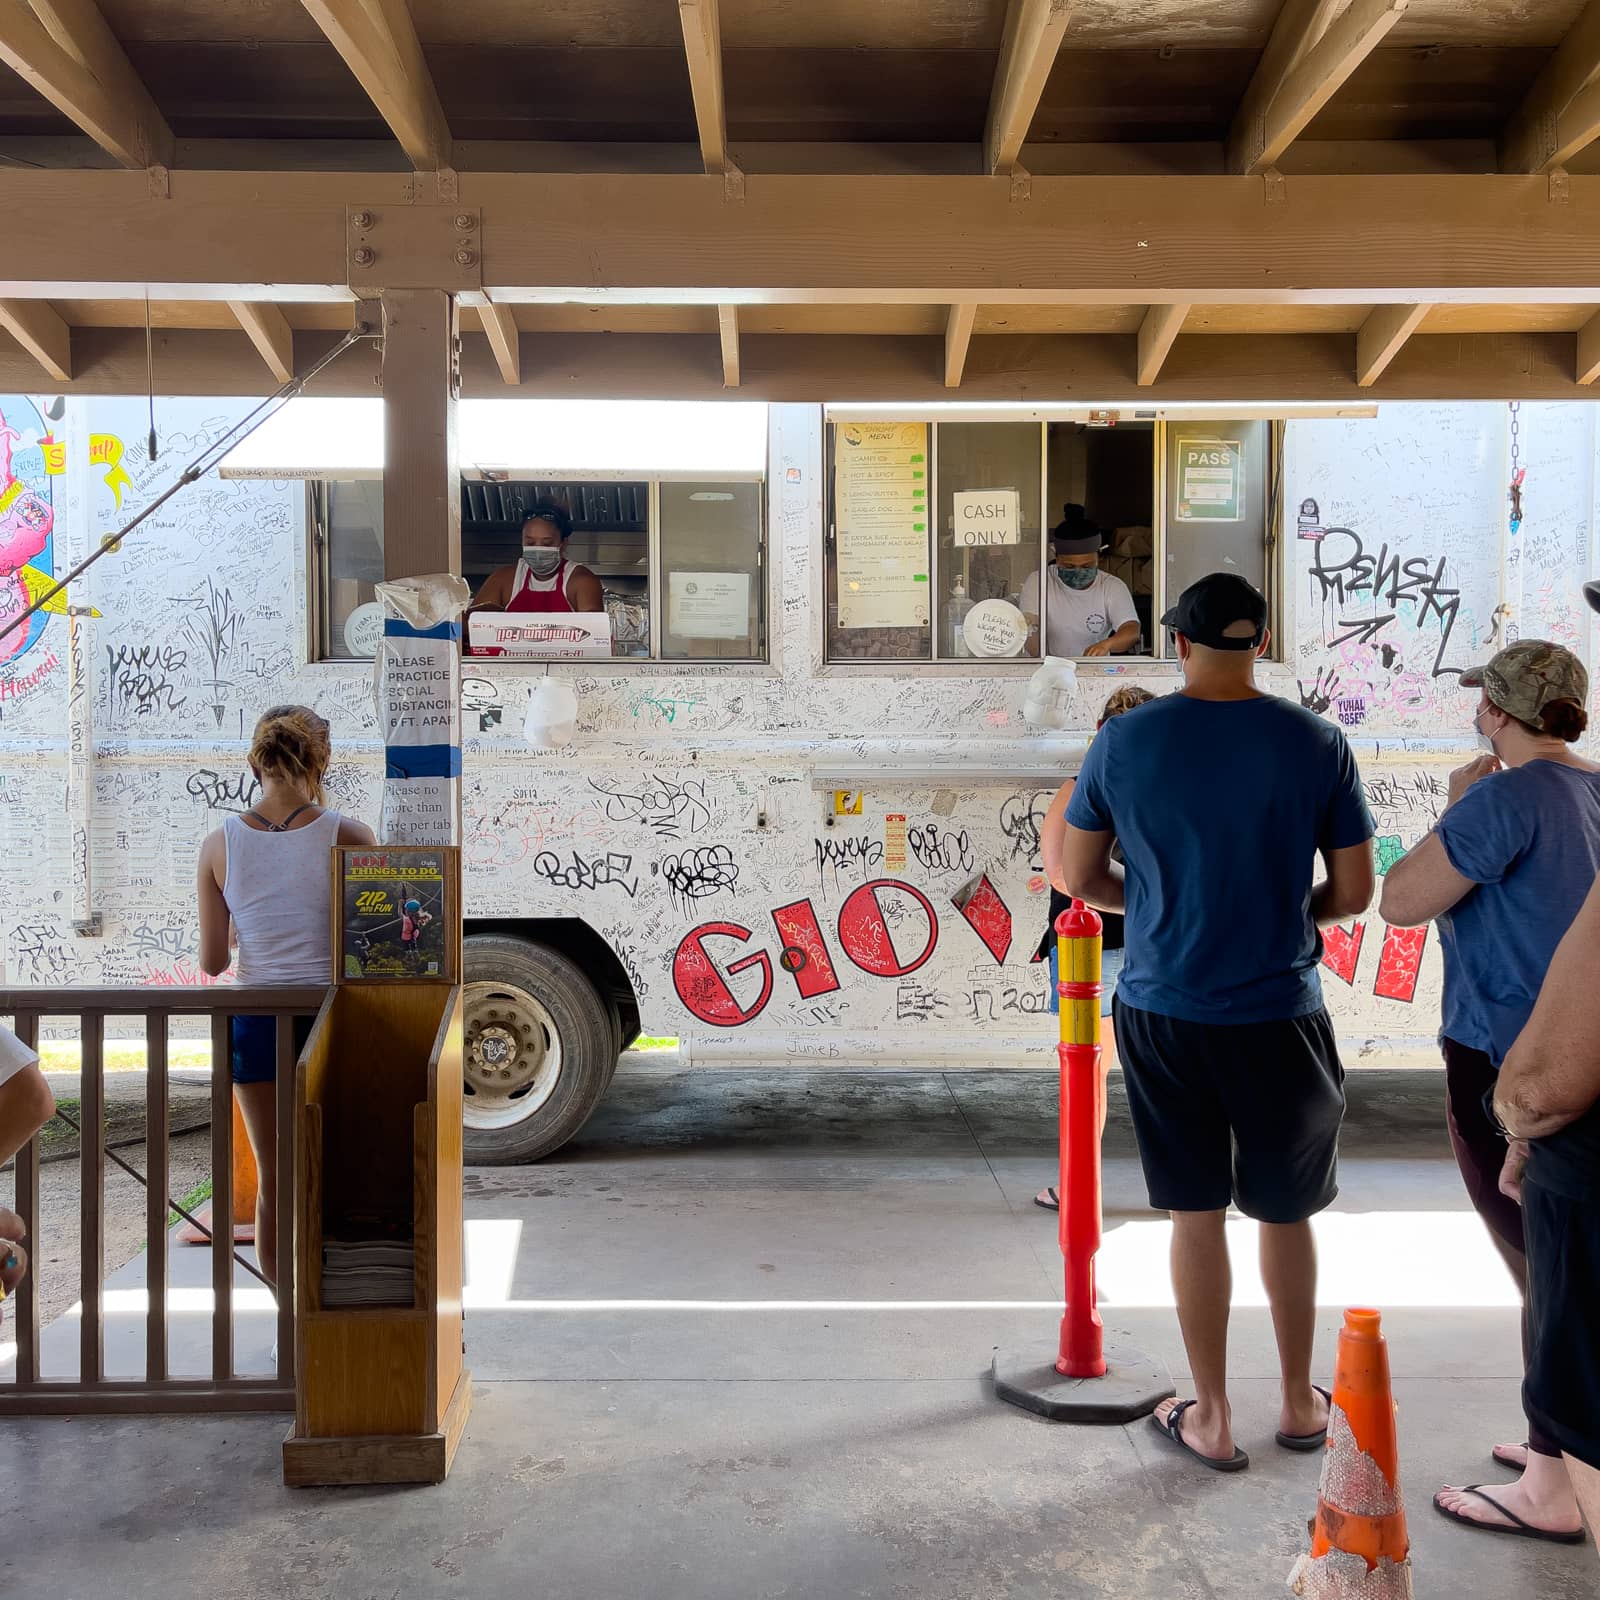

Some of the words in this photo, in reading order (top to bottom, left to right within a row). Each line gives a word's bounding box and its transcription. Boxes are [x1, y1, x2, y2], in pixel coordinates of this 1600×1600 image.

[1188, 452, 1231, 465] PASS
[963, 504, 1006, 519] CASH
[964, 531, 1007, 545] ONLY
[982, 613, 1010, 627] PLEASE
[496, 629, 520, 642] Foil
[522, 629, 583, 642] Aluminum
[388, 657, 435, 667] PLEASE
[388, 671, 450, 682] PRACTICE
[389, 686, 436, 697] SOCIAL
[390, 717, 398, 727] 6
[385, 786, 421, 796] Please
[424, 786, 439, 794] no
[385, 804, 414, 814] more
[417, 802, 442, 812] than
[386, 821, 407, 832] five
[410, 822, 429, 832] per
[415, 837, 450, 846] Mahalo
[350, 867, 398, 875] THINGS
[400, 867, 417, 875] TO
[419, 867, 438, 875] DO
[355, 891, 387, 908] ZIP
[374, 904, 393, 912] FUN
[786, 1040, 826, 1053] Junie
[829, 1042, 839, 1057] B
